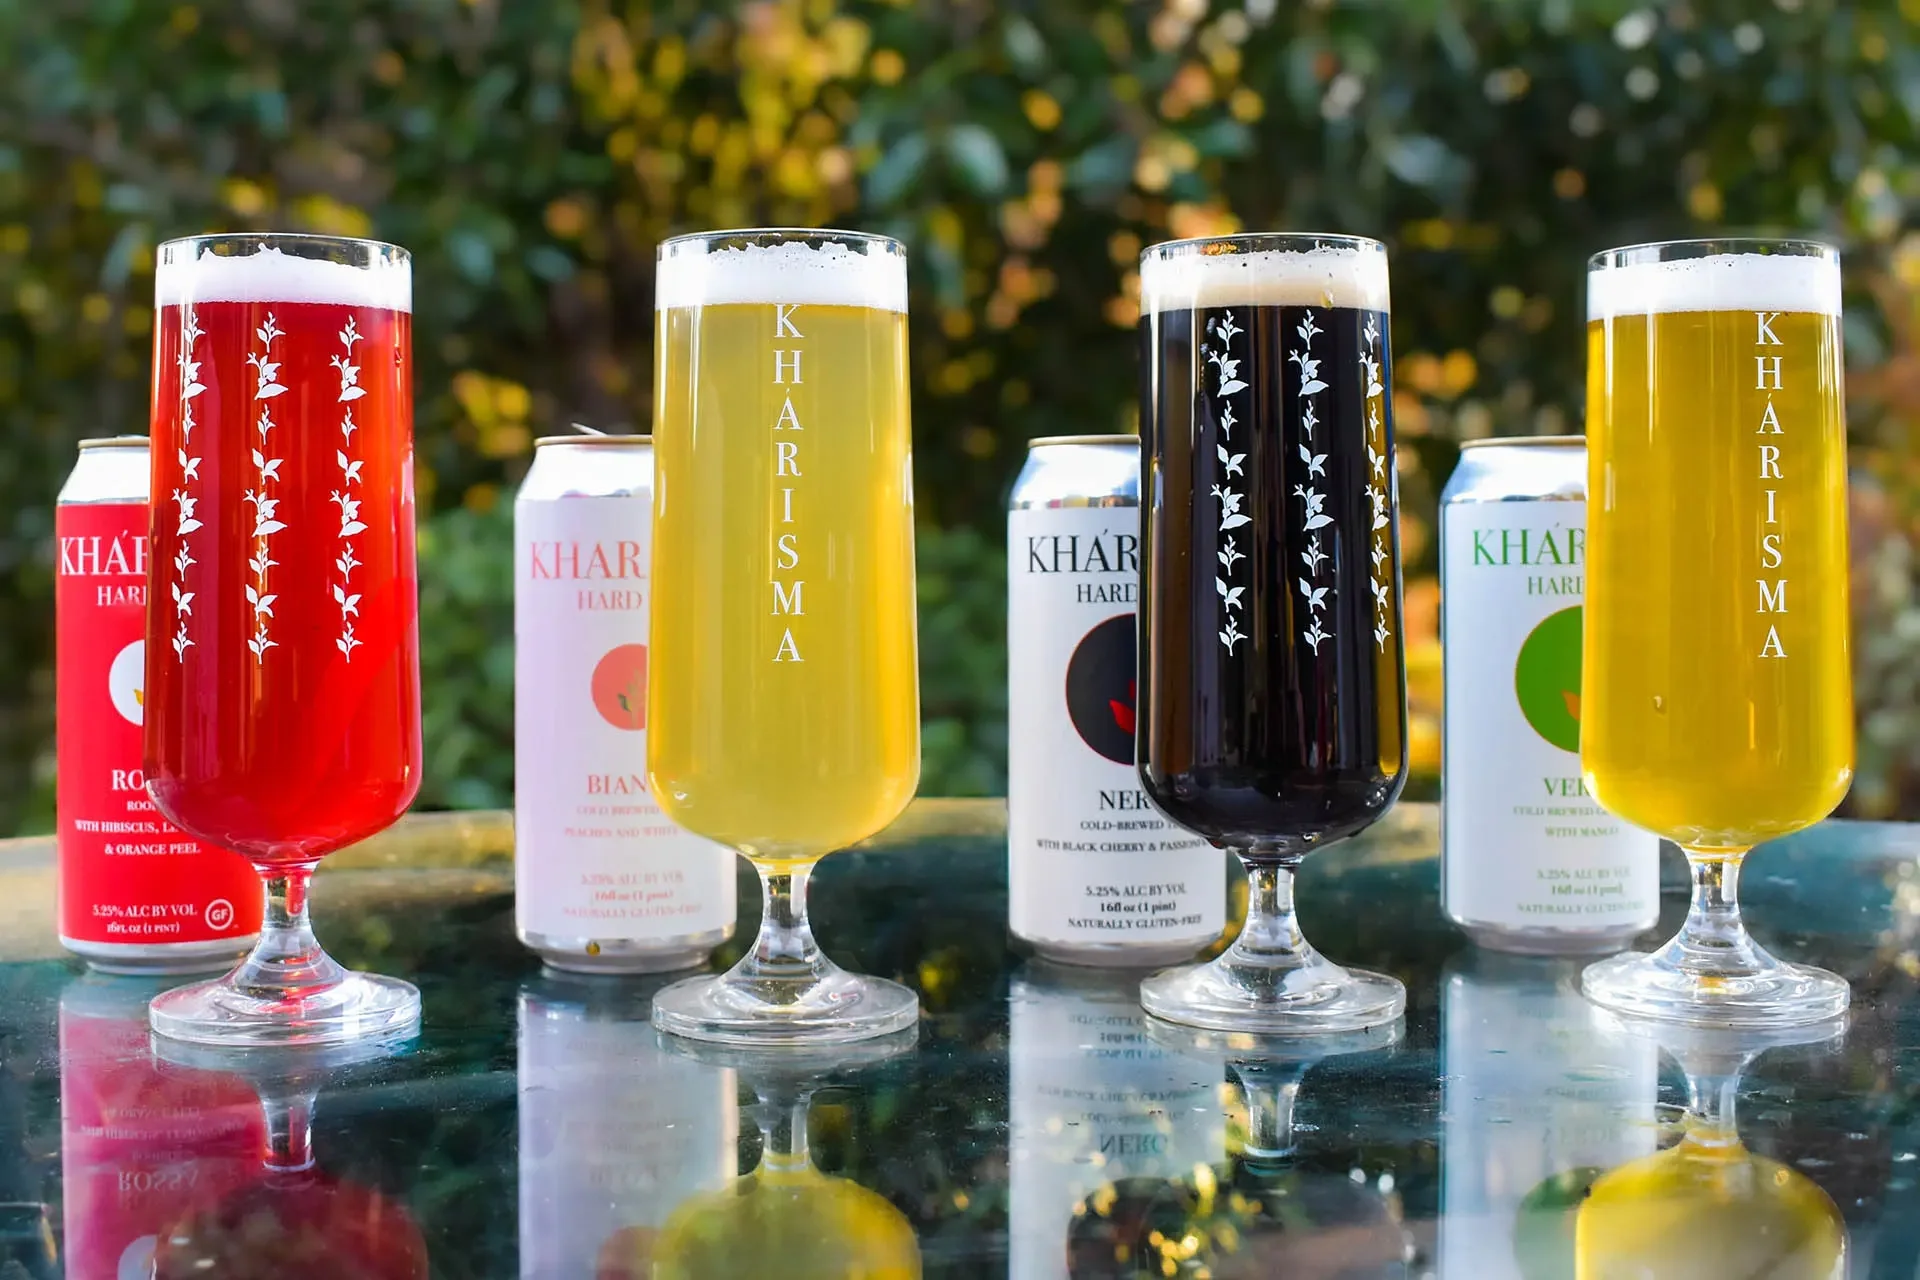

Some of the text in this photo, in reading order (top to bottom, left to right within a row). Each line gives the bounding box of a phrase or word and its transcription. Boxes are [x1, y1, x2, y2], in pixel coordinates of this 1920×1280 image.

[577, 589, 643, 611] HARD
[104, 842, 201, 856] & ORANGE PEEL
[1062, 841, 1097, 853] BLACK
[1100, 842, 1145, 853] CHERRY
[125, 904, 149, 918] ALC
[152, 905, 168, 917] BY
[1067, 917, 1132, 930] NATURALLY
